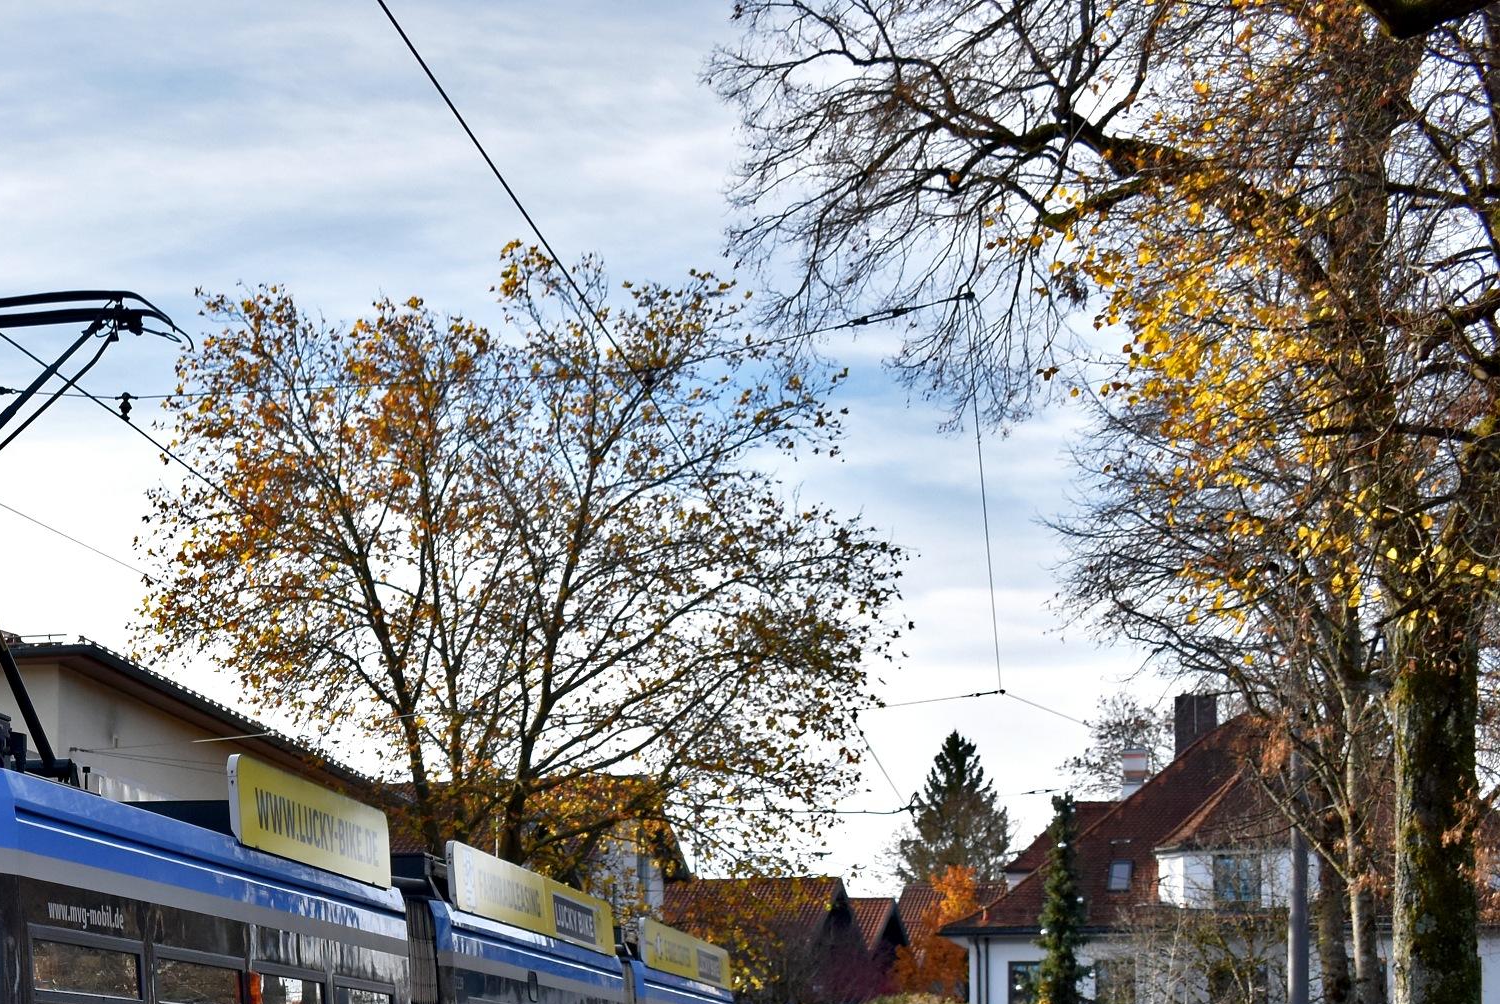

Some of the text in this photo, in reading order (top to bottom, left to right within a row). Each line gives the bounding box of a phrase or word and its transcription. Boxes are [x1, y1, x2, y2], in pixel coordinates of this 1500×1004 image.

[255, 787, 379, 867] WWW.LUCKY-BIKE.DE
[48, 902, 124, 930] www.mvg-mobil.de
[555, 902, 594, 938] LUCKY BIKE
